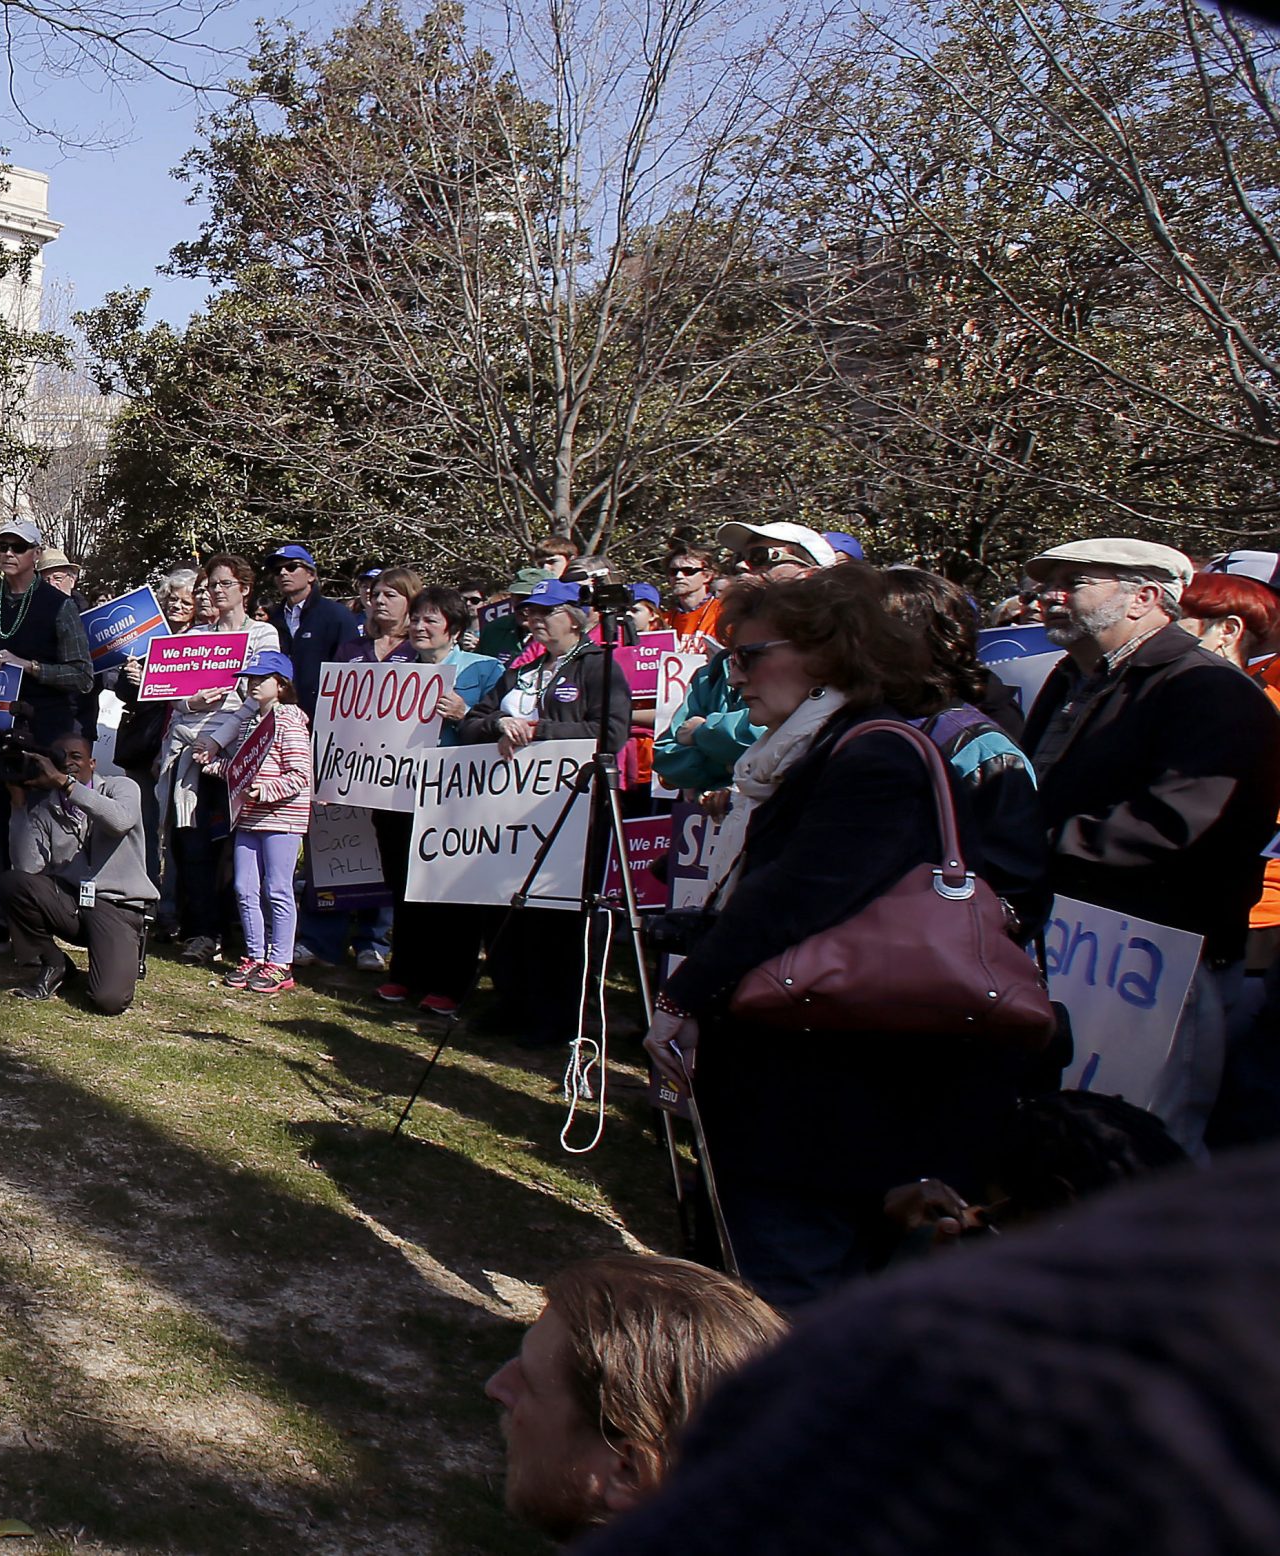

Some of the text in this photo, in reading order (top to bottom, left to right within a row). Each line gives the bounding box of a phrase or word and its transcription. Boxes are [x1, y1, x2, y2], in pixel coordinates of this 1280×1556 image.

[95, 614, 136, 642] VIRGINIA
[162, 645, 232, 659] We Rally for
[639, 646, 659, 656] for
[148, 658, 241, 674] Women's Health
[320, 669, 444, 724] 400,000
[418, 757, 580, 808] HANOVER
[315, 829, 361, 853] Care
[418, 823, 549, 862] COUNTY
[629, 837, 651, 851] We
[328, 847, 382, 878] ALL!
[659, 1088, 678, 1103] SEIU
